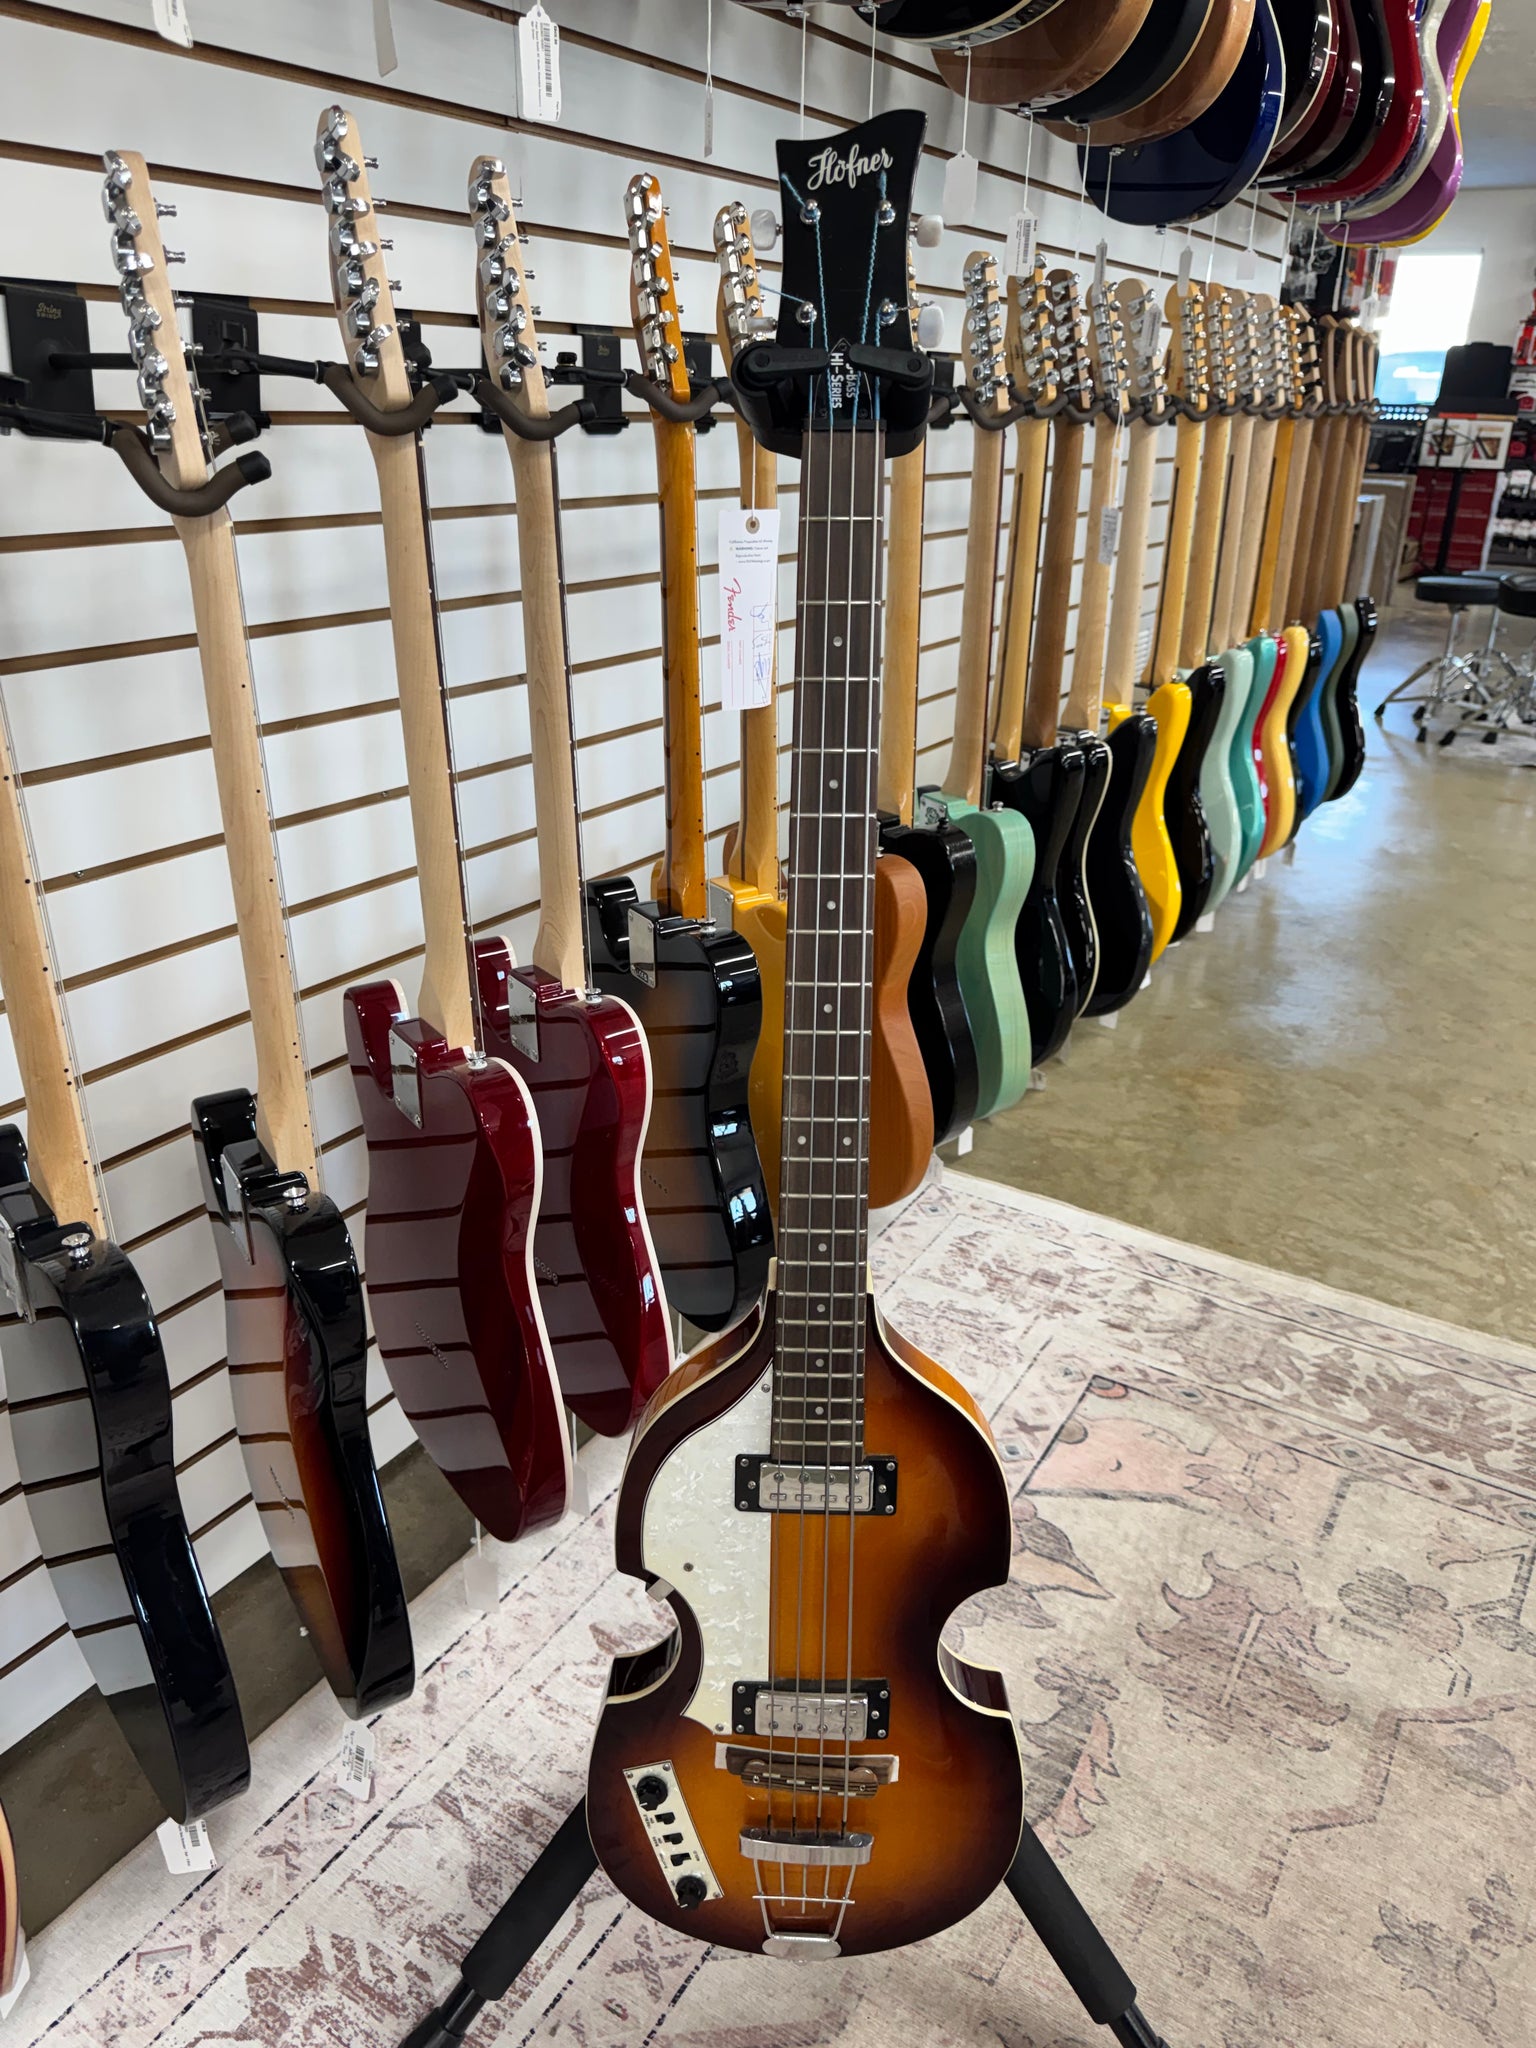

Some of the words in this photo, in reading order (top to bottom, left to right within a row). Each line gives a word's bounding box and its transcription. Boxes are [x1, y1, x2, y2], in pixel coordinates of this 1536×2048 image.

[807, 144, 893, 190] Höfner
[830, 352, 844, 409] HI-SERIES
[723, 578, 742, 632] Fender
